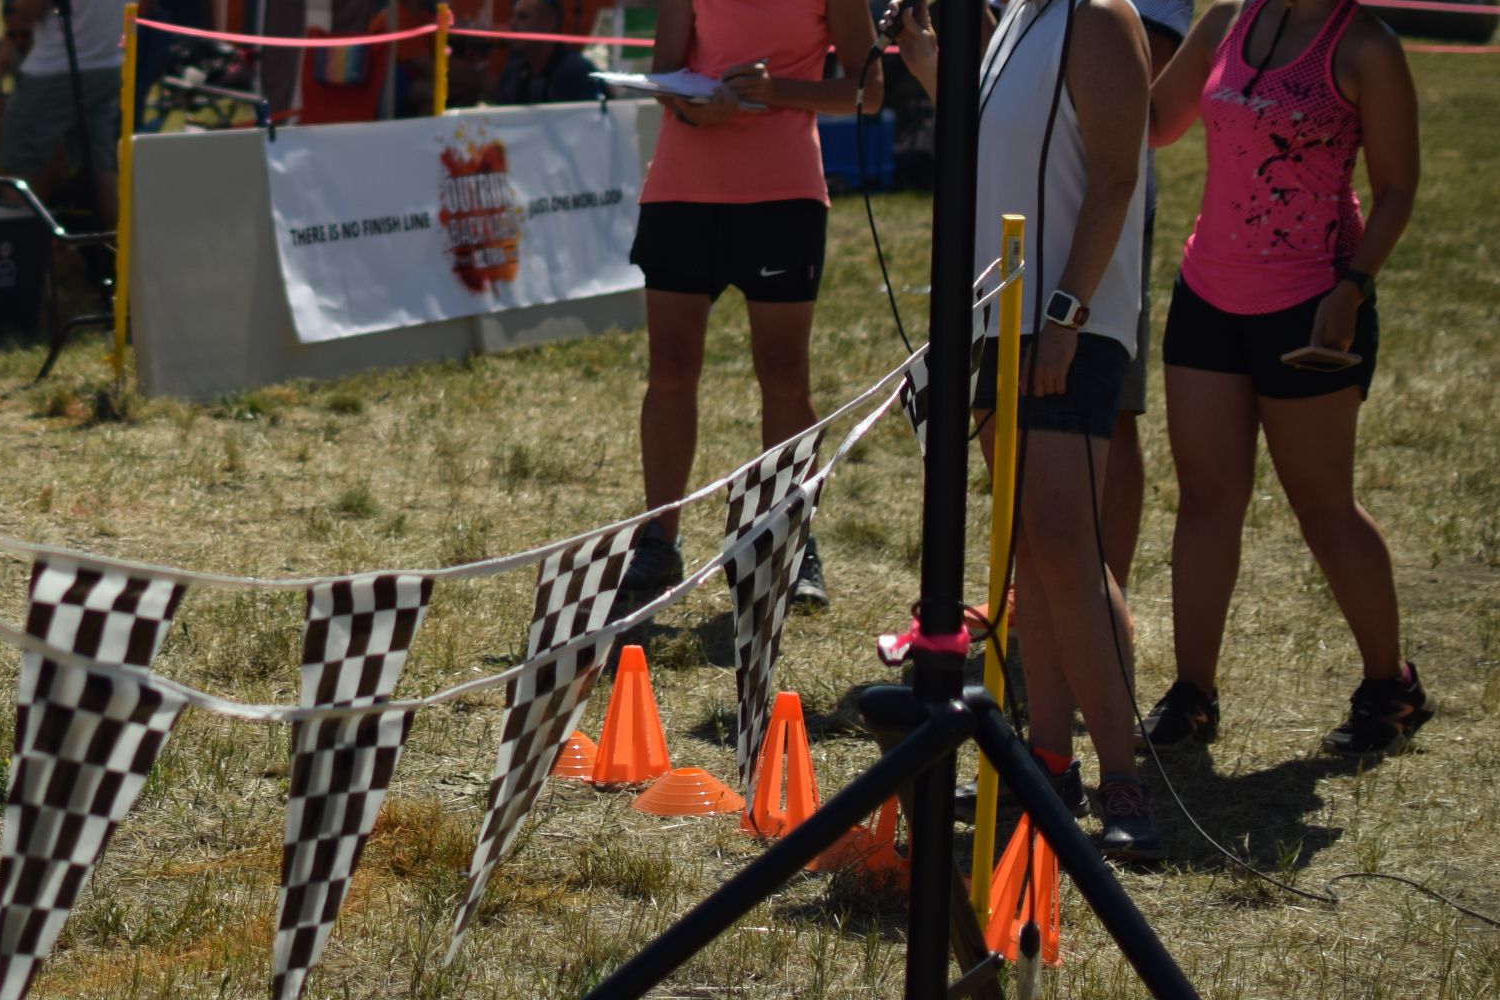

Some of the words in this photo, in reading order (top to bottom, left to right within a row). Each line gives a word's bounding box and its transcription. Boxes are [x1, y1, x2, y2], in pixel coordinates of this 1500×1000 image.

[290, 225, 326, 246] THERE
[329, 224, 340, 241] IS
[342, 221, 360, 240] NO
[362, 216, 400, 237] FINISH
[404, 212, 430, 231] LINE
